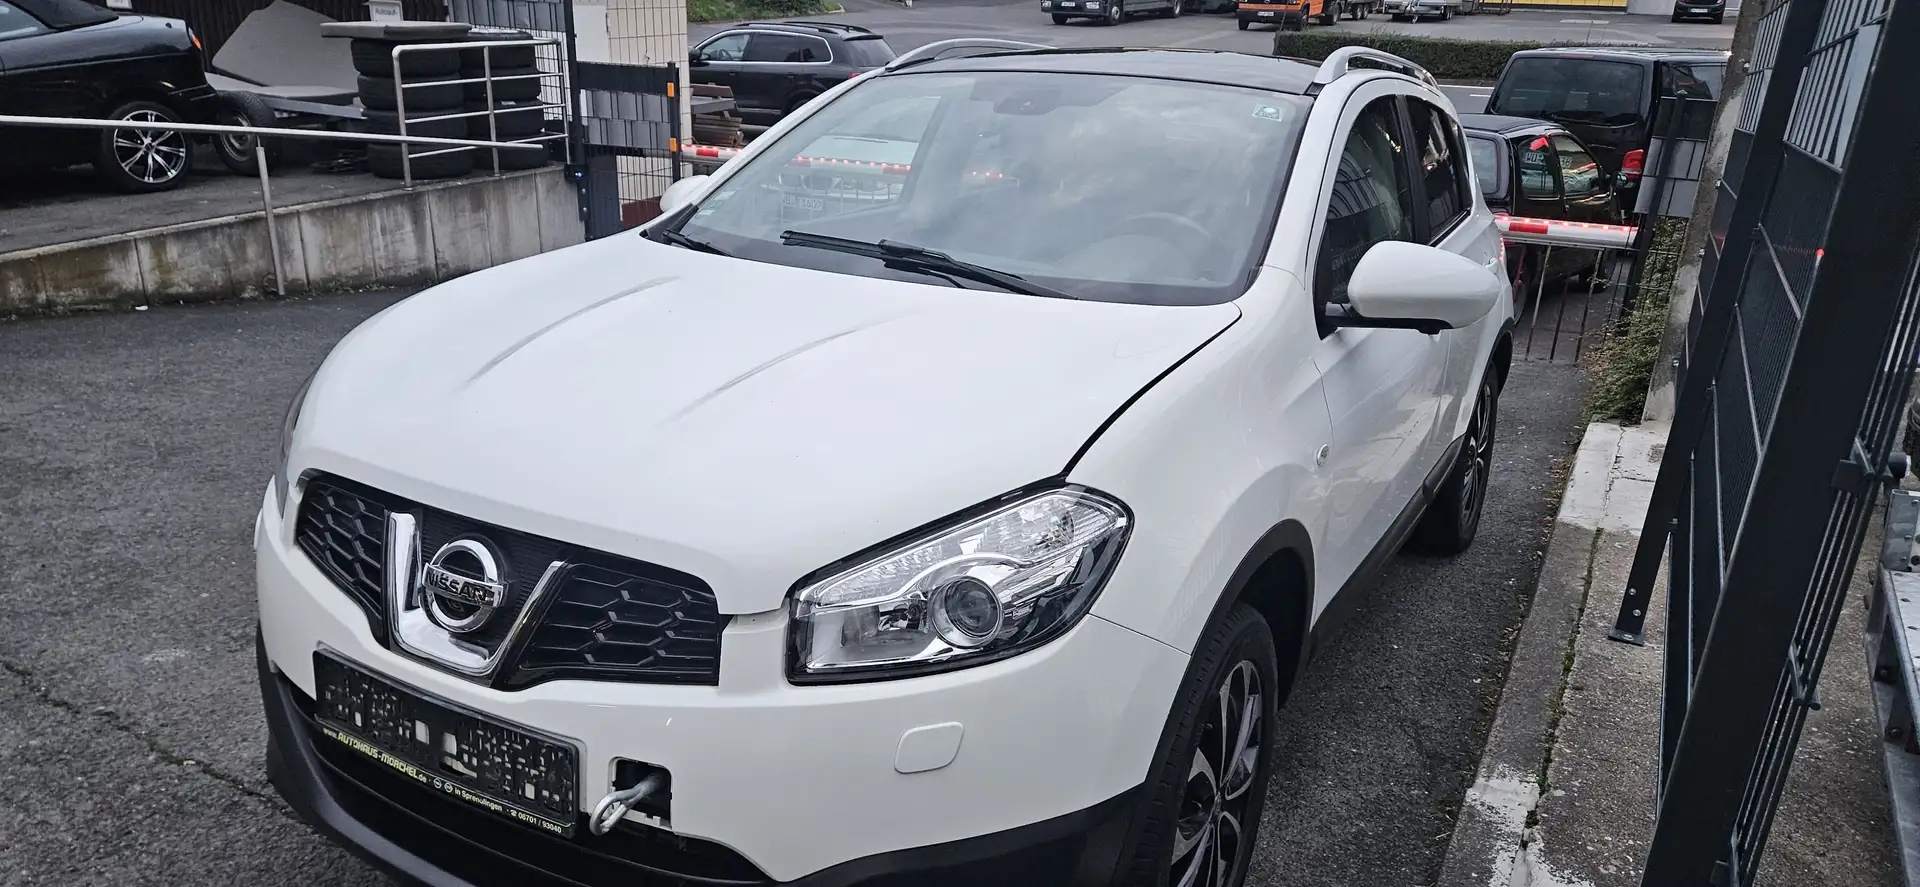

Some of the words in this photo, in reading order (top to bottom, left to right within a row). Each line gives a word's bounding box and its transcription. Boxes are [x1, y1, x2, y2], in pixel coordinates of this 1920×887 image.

[426, 569, 487, 602] NISSAN
[518, 811, 537, 824] 06701
[542, 821, 562, 834] 93040
